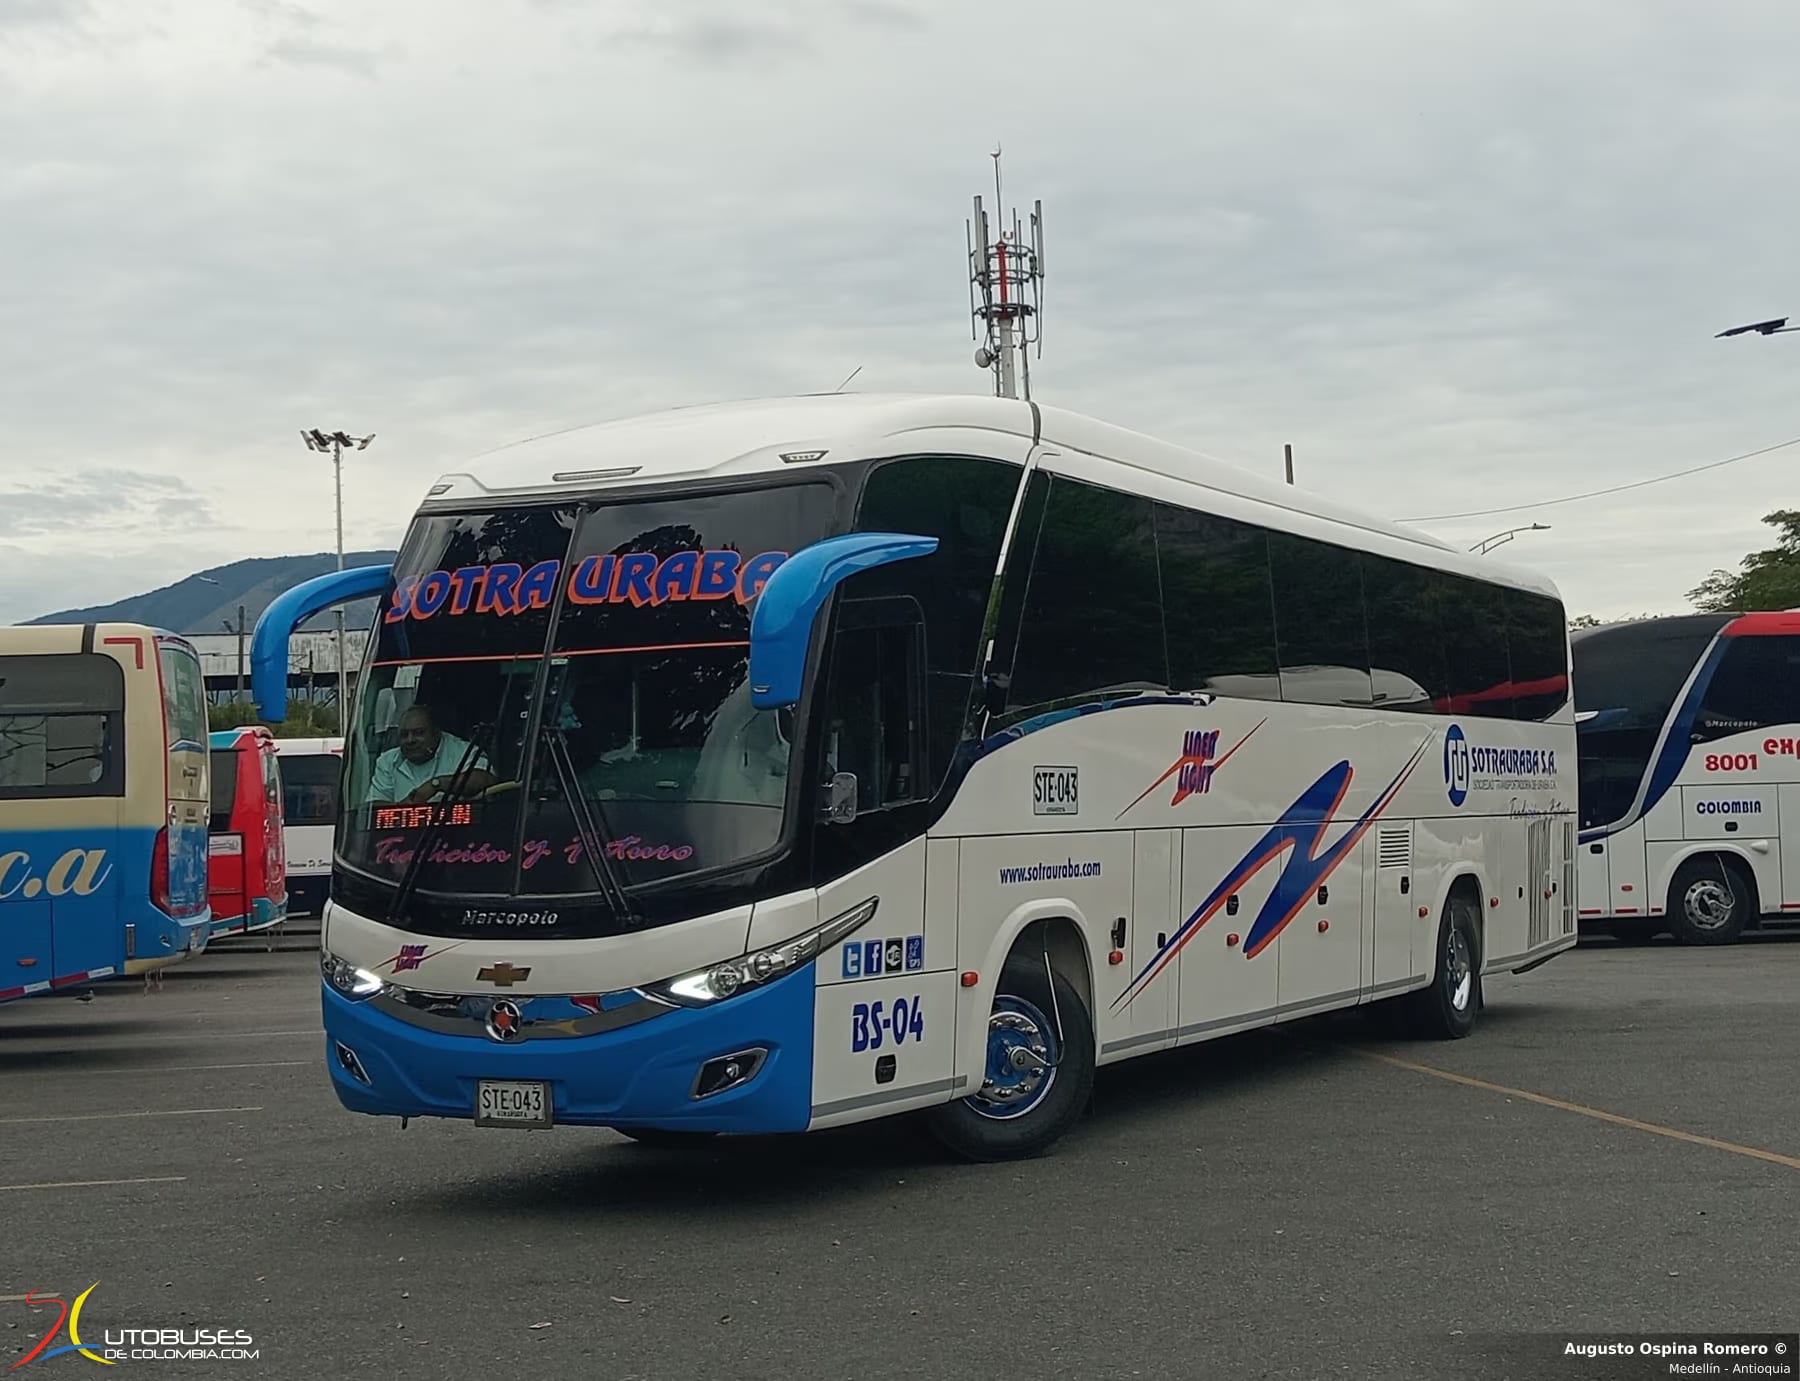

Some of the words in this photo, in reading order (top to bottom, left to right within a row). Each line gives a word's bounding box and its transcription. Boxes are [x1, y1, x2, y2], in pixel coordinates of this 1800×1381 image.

[384, 560, 560, 624] SOTRA
[567, 550, 790, 607] URABA
[1471, 746, 1539, 776] SOTRAURABA
[1763, 738, 1800, 761] ex
[1705, 754, 1758, 772] 8001
[1696, 800, 1762, 814] COLOMBIA
[999, 857, 1101, 885] www.sotrauraba.com
[461, 909, 559, 928] Marcopolo
[852, 994, 923, 1053] BS-04
